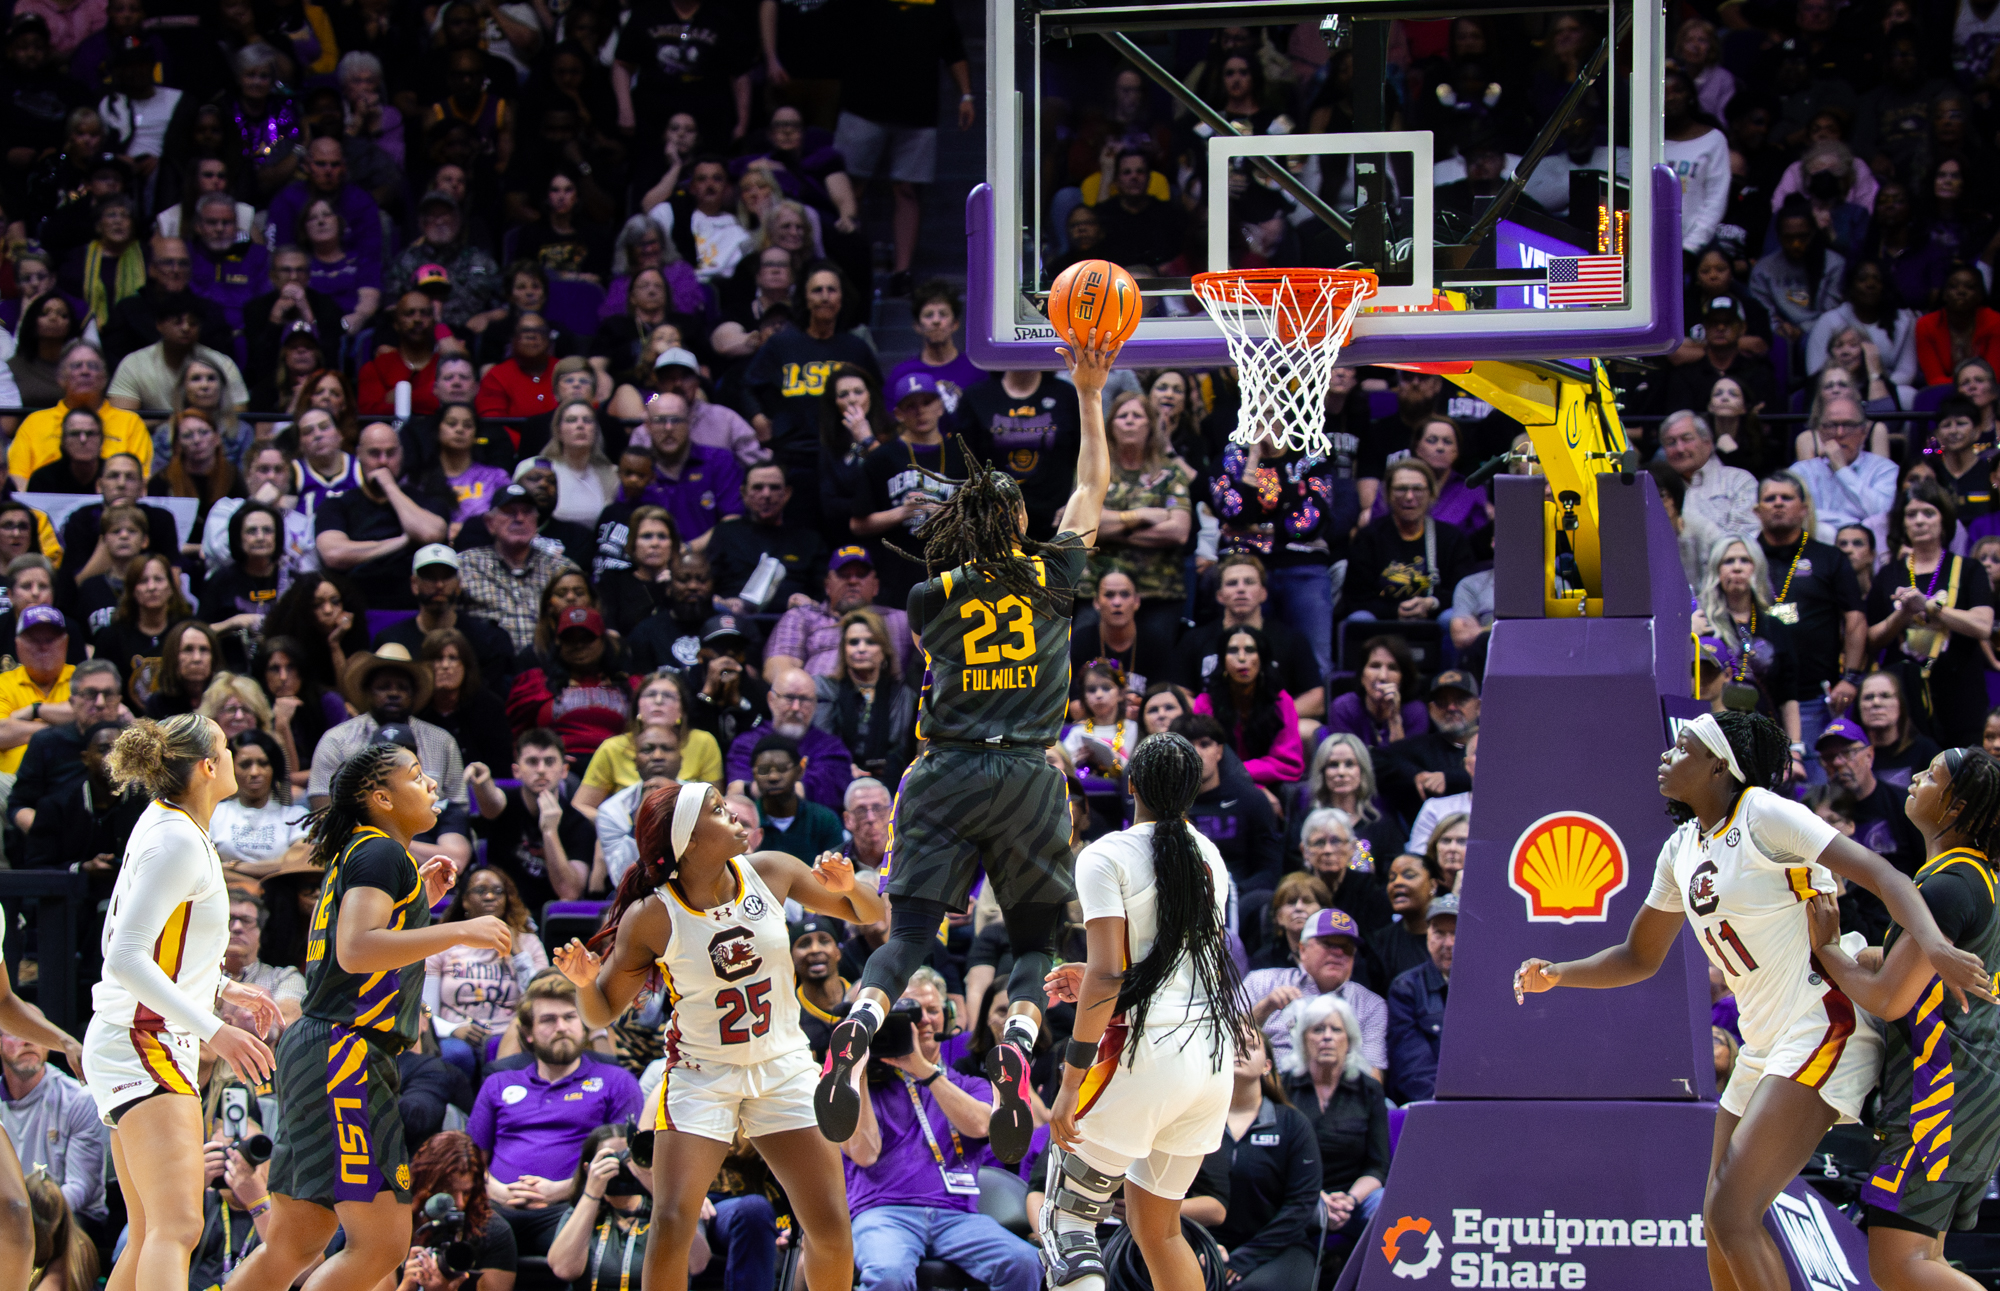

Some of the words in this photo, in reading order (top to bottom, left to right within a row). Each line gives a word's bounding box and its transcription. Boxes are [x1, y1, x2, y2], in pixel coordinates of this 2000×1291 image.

[1079, 270, 1103, 321] ELITE
[1014, 327, 1060, 341] SPALD
[908, 376, 923, 392] L
[960, 593, 1037, 666] 23
[962, 664, 1039, 692] FULWILEY
[1704, 919, 1760, 977] 11
[714, 976, 772, 1045] 25
[333, 1097, 370, 1185] LSU
[1250, 1133, 1281, 1147] LSU
[1452, 1208, 1708, 1254] Equipment
[1450, 1252, 1587, 1290] Share
